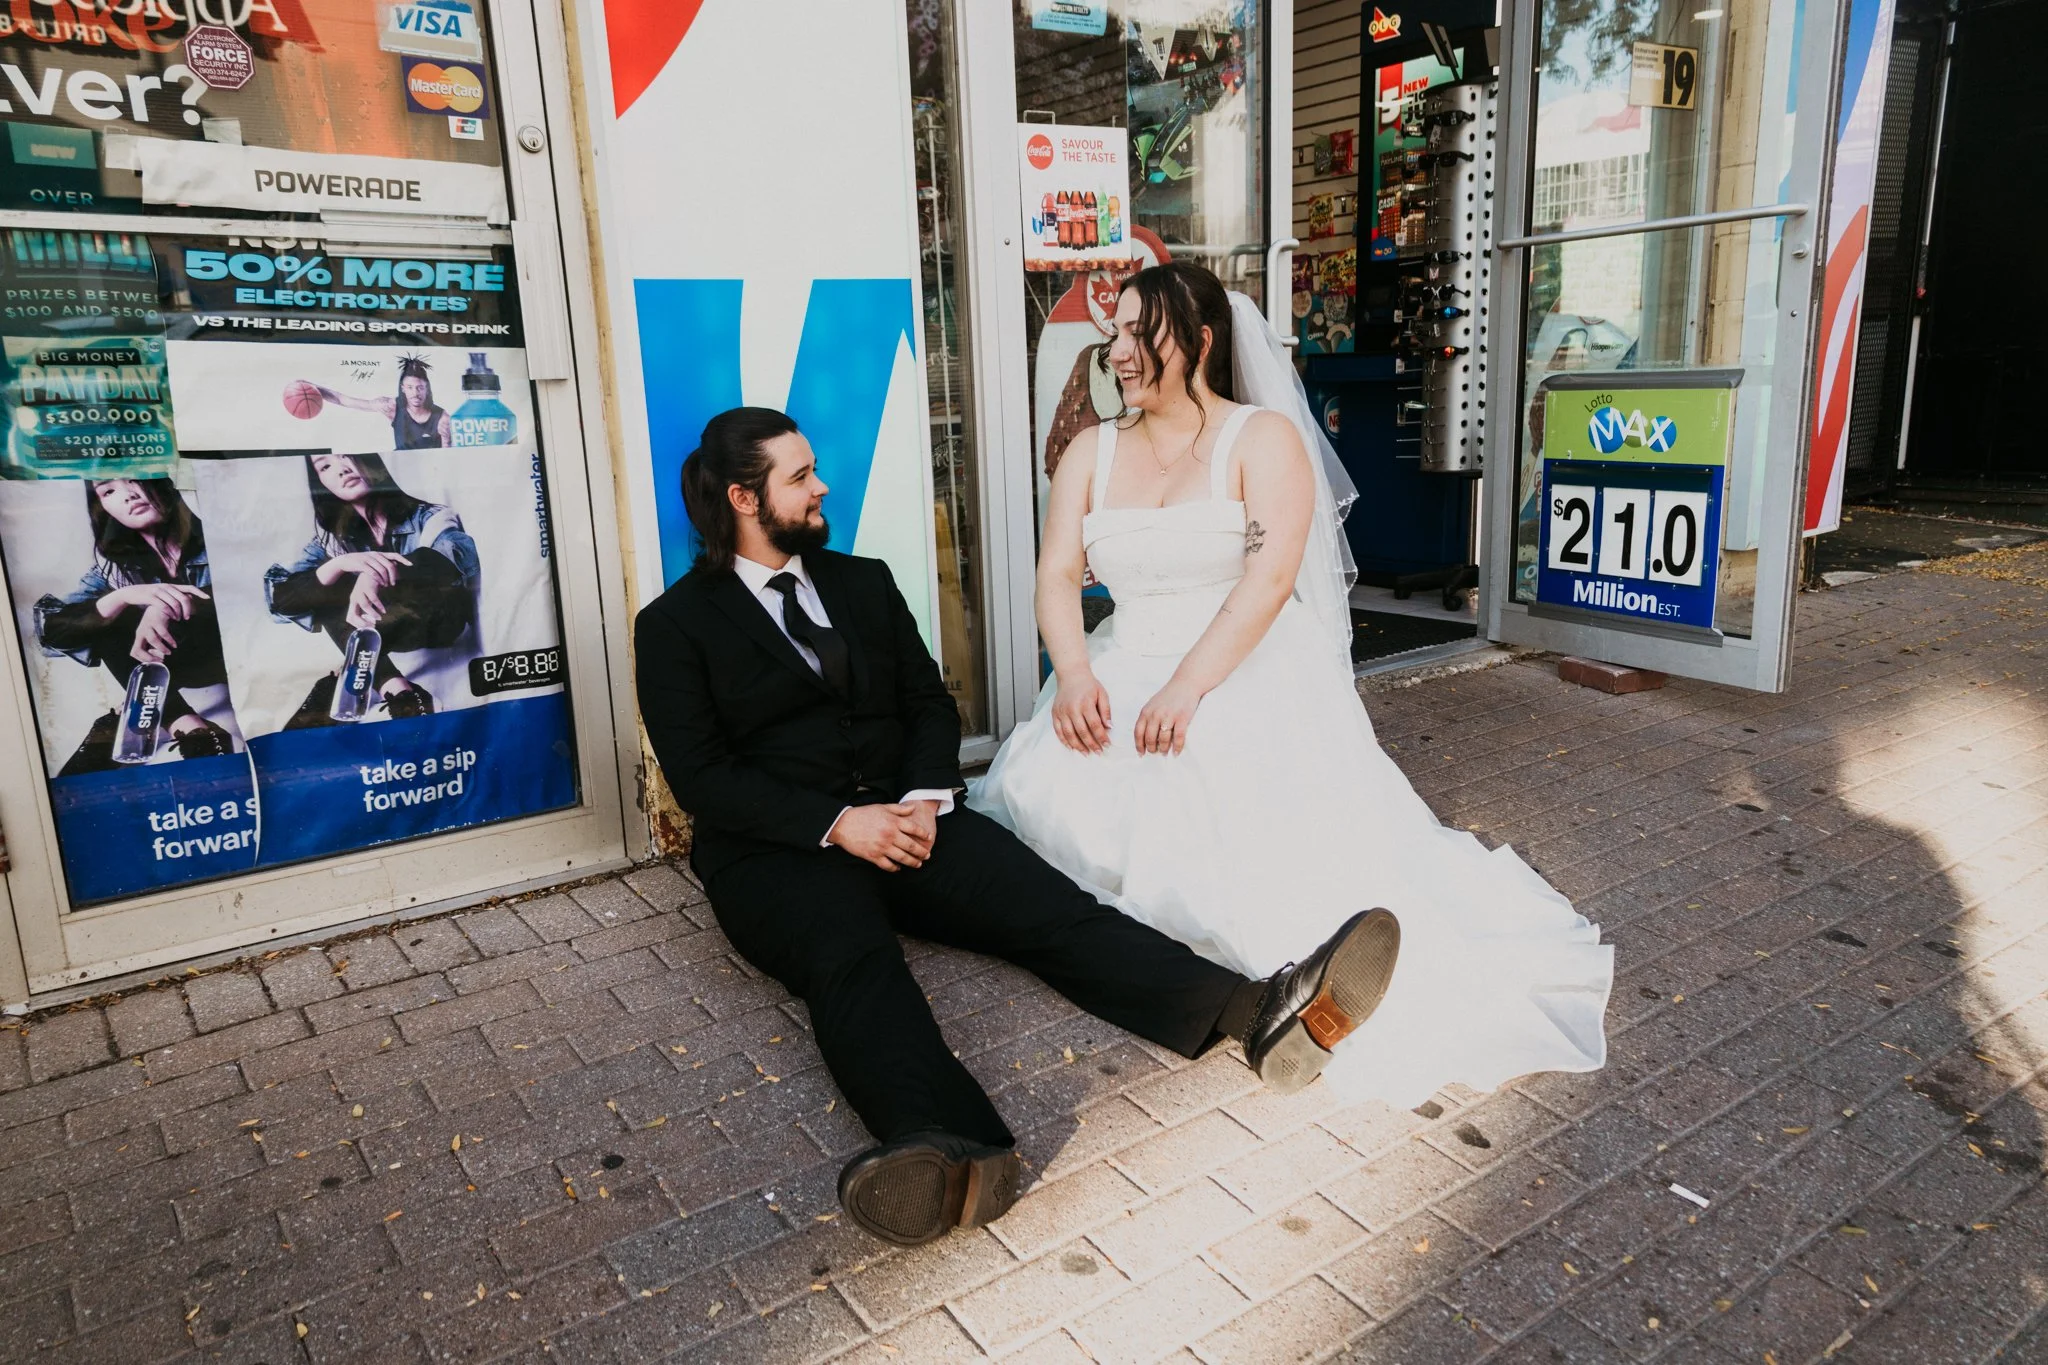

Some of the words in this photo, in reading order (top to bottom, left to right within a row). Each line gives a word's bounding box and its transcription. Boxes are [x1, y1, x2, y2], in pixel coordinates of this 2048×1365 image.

[395, 7, 462, 38] VISA
[193, 39, 216, 47] ALARM
[216, 42, 243, 50] SYSTEM
[196, 33, 237, 43] ELECTRONIC
[190, 45, 249, 64] FORCE
[193, 59, 233, 70] SECURITY
[1403, 76, 1429, 95] NEW
[1663, 49, 1695, 106] 19
[411, 78, 481, 98] MasterCard
[1062, 138, 1104, 150] SAVOUR
[1062, 151, 1082, 163] THE
[1085, 153, 1117, 163] TASTE
[254, 170, 421, 202] POWERADE
[30, 188, 94, 206] OVER
[185, 250, 332, 285] 50%
[343, 258, 505, 291] MORE
[6, 288, 78, 301] PRIZES
[5, 304, 53, 319] $100
[62, 305, 102, 317] AND
[110, 306, 158, 320] $500
[192, 315, 226, 328] VS
[228, 316, 272, 330] THE
[275, 318, 365, 334] LEADING
[368, 322, 449, 336] SPORTS
[452, 323, 511, 336] DRINK
[40, 351, 69, 362] BIG
[77, 351, 136, 362] MONEY
[451, 418, 508, 433] POWER
[1589, 406, 1674, 453] MAX
[65, 436, 92, 446] $20
[81, 448, 117, 458] $100
[129, 446, 165, 456] $500
[530, 453, 551, 559] smartwater
[1573, 579, 1657, 614] Million
[1658, 604, 1681, 618] EST.
[353, 650, 372, 690] smart
[138, 685, 159, 728] smart
[360, 758, 417, 786] take
[422, 757, 438, 775] a
[443, 746, 477, 770] sip
[363, 772, 464, 813] forward
[148, 803, 214, 832] take
[220, 801, 240, 820] a
[152, 828, 257, 860] forwar
